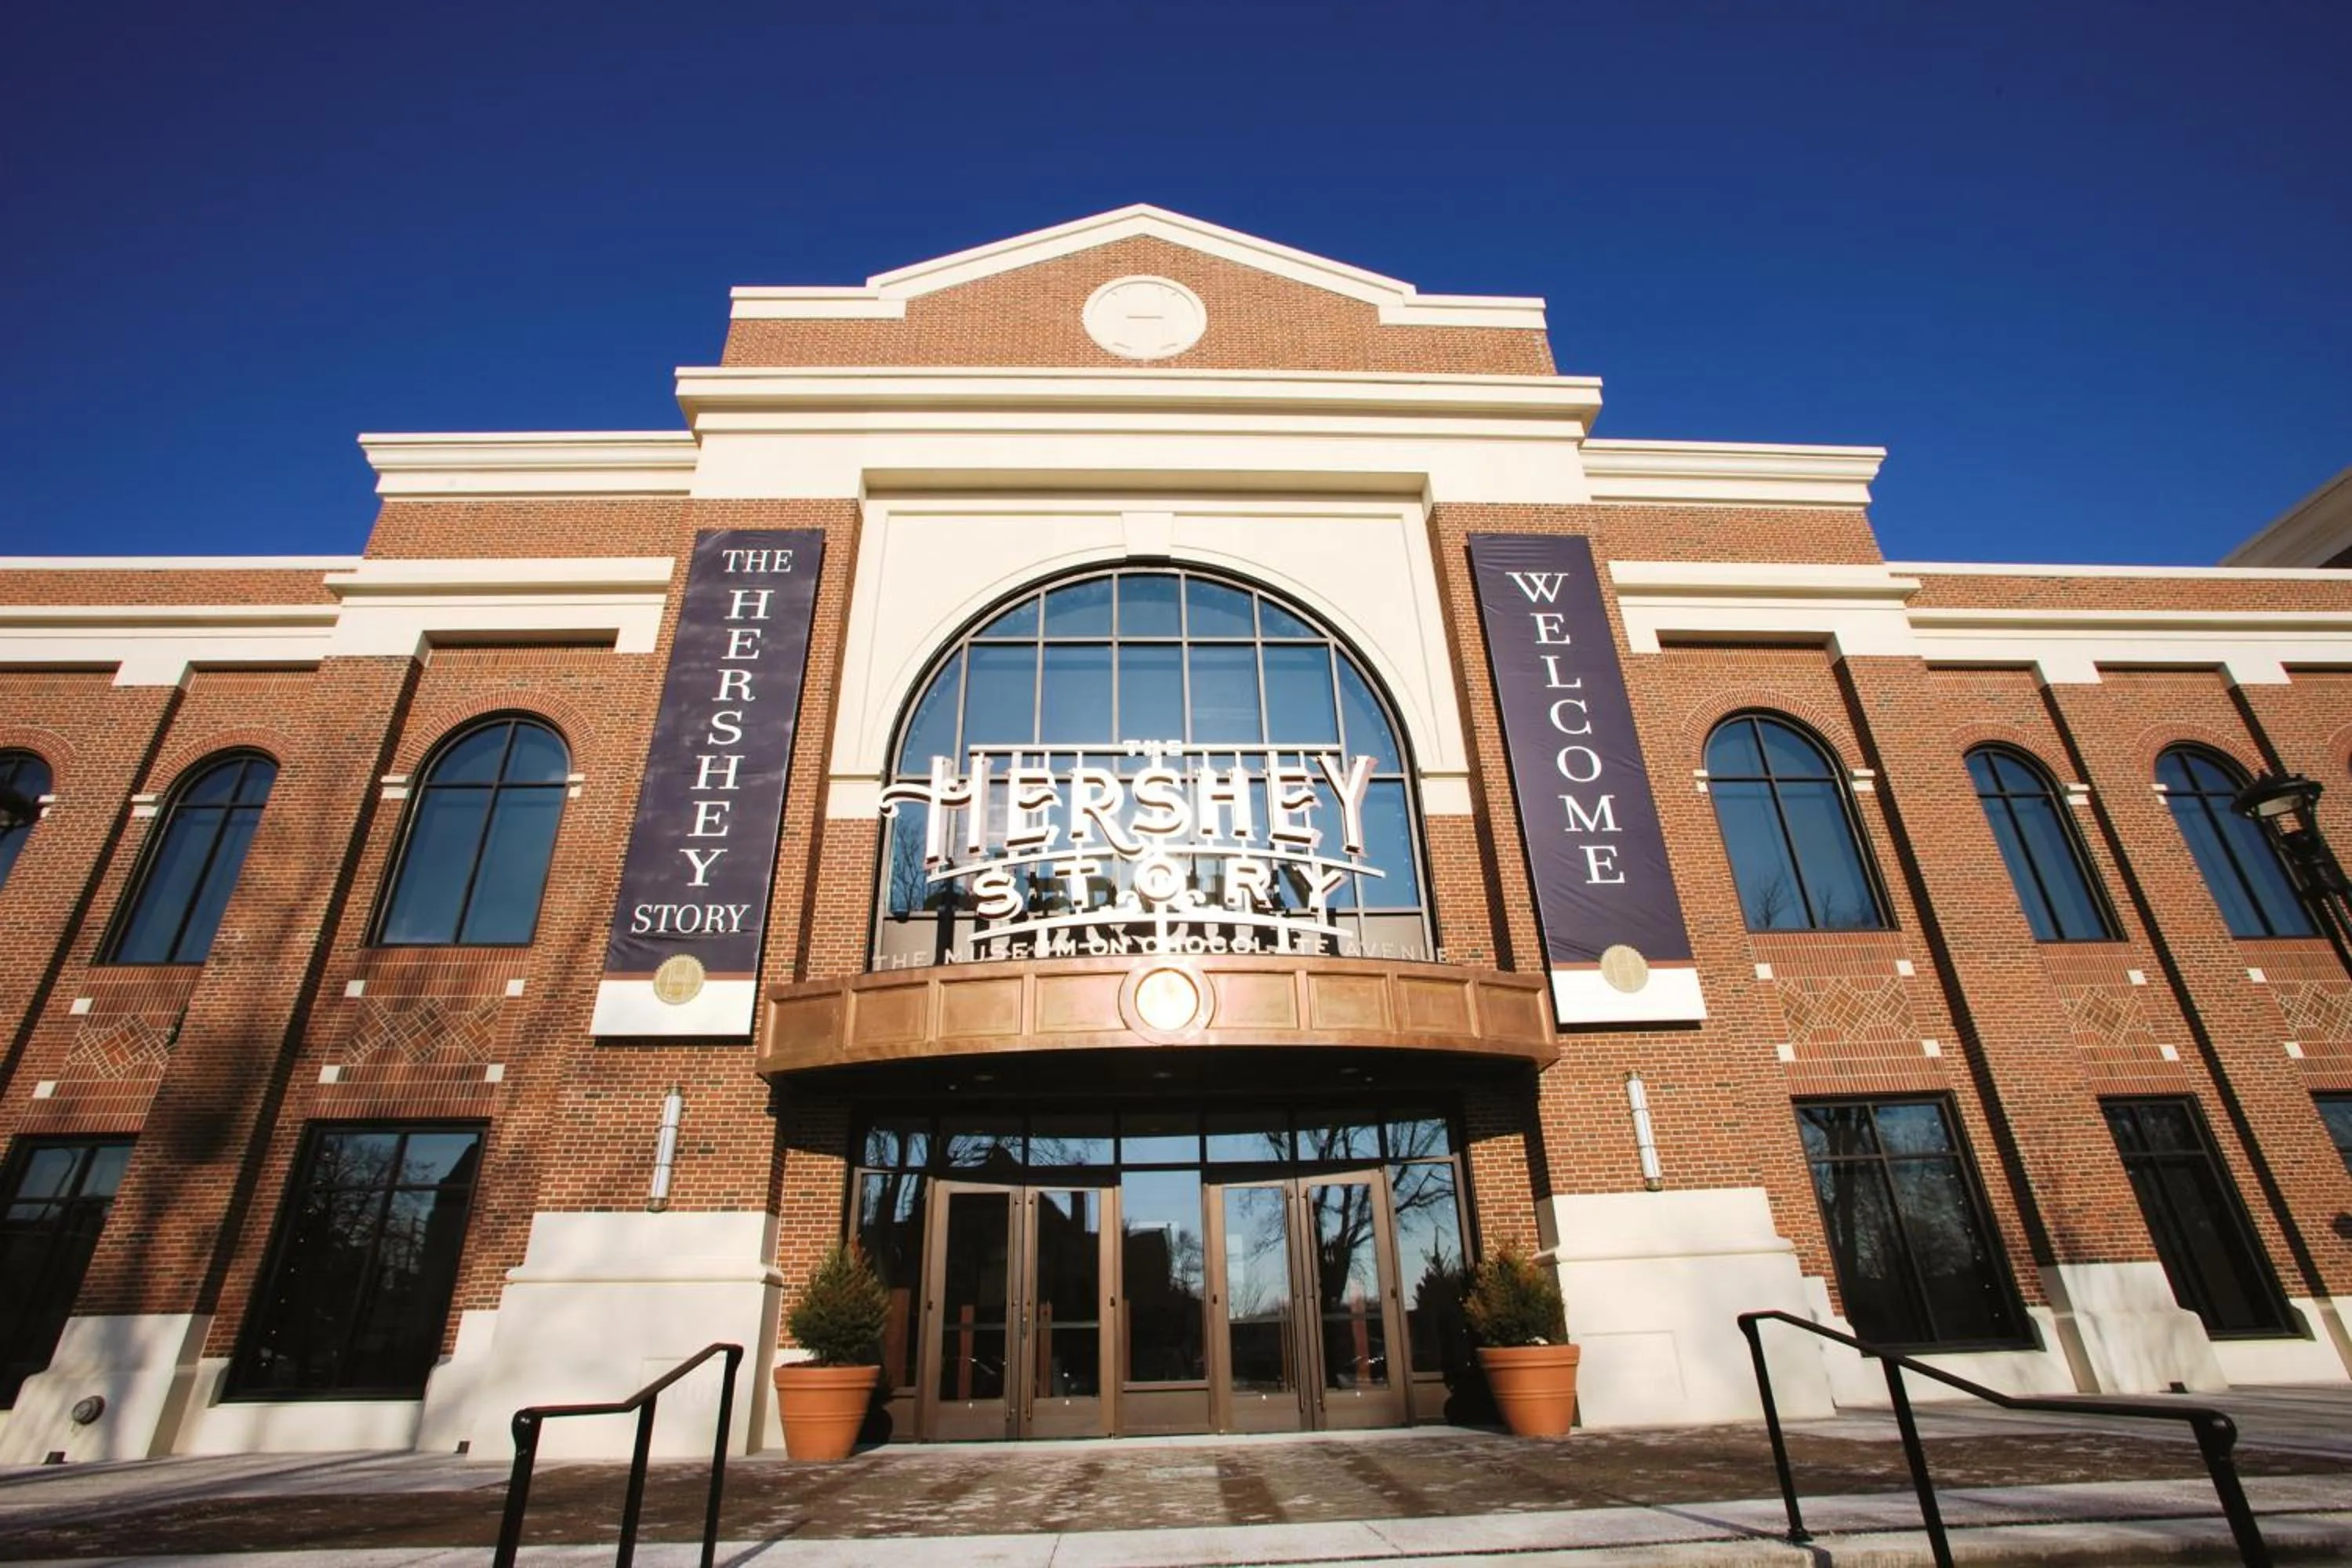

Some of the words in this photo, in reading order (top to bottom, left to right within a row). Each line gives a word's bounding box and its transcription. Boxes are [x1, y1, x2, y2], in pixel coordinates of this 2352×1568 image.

[723, 550, 793, 573] THE
[679, 589, 775, 887] HERSHEY
[1122, 739, 1182, 757] THE
[1505, 572, 1625, 885] WELCOME
[878, 755, 1379, 870] HERSHEY
[972, 857, 1348, 921] STORY
[630, 904, 751, 934] STORY
[872, 951, 930, 972] THE
[1088, 939, 1127, 956] ON
[1345, 942, 1449, 964] AVENUE
